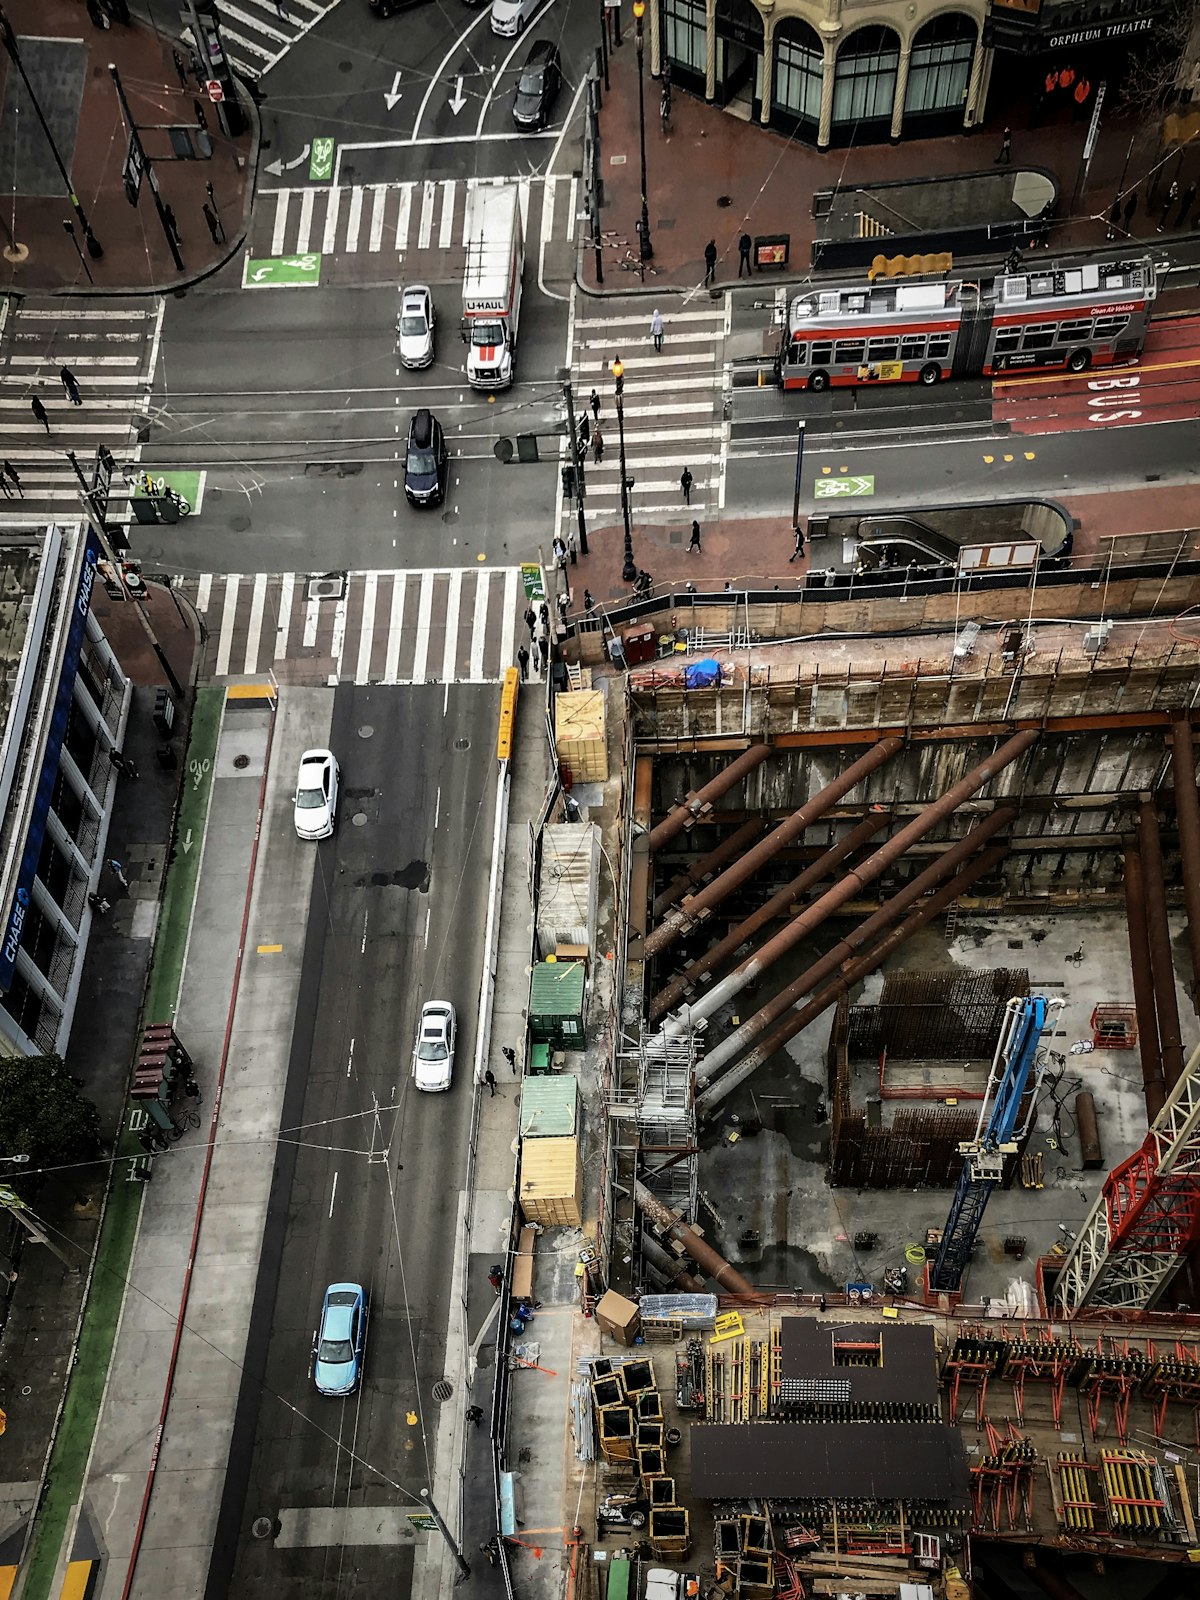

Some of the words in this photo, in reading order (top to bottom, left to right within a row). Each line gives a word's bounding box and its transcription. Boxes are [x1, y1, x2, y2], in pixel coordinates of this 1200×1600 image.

[1049, 28, 1101, 48] ORPHEUM
[1106, 18, 1154, 37] THEATRE
[467, 301, 504, 310] U-HAUL
[1090, 308, 1107, 316] Clean
[1106, 306, 1116, 314] Air
[1115, 303, 1135, 313] Vehicle
[1087, 376, 1142, 422] BUS
[78, 561, 94, 617] CHASE
[5, 902, 26, 963] CHASE
